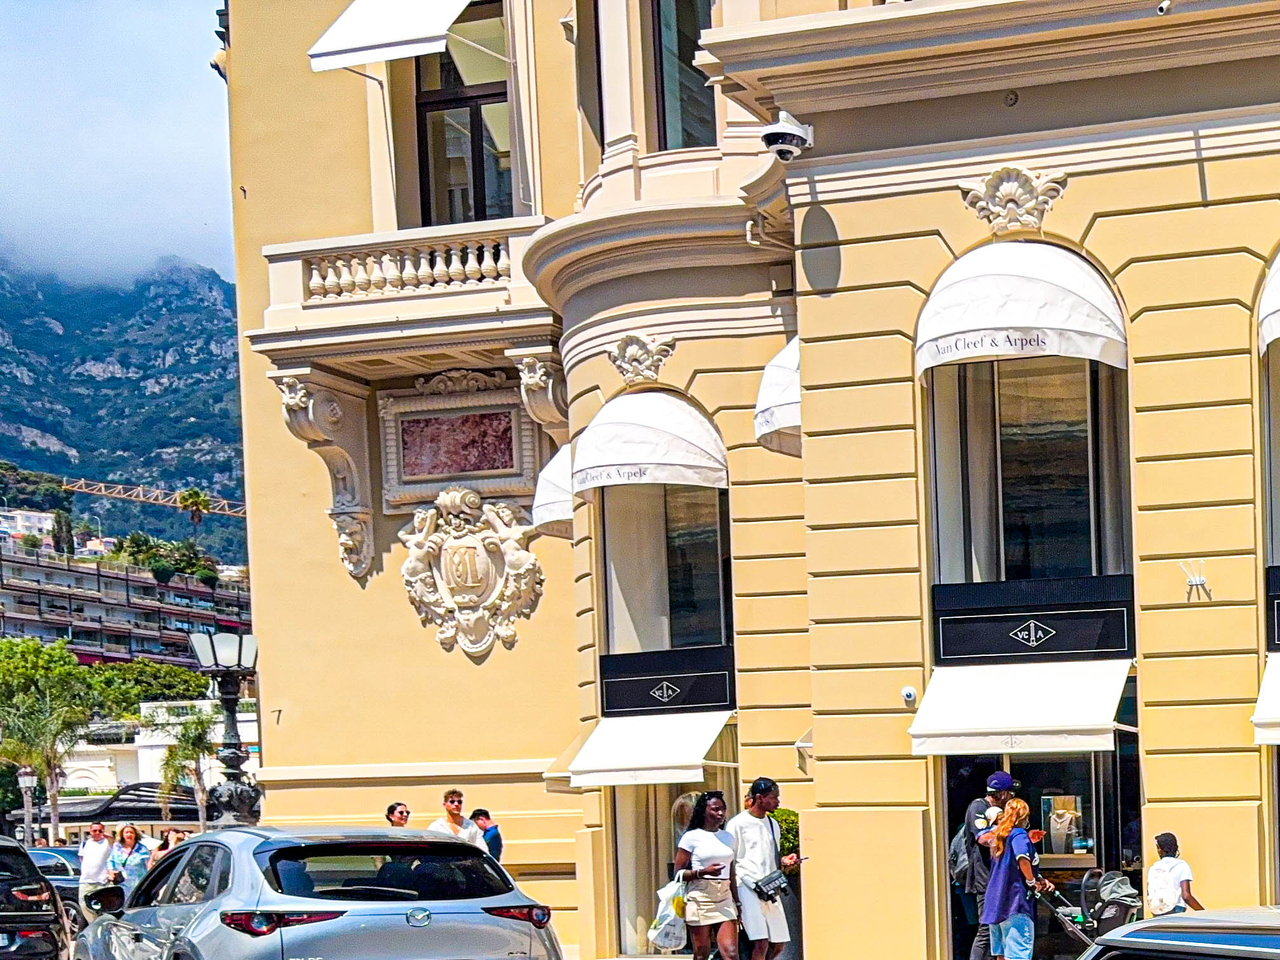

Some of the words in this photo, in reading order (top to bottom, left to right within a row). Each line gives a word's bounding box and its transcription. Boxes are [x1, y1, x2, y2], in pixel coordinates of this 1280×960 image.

[954, 335, 987, 351] Cleef
[990, 338, 999, 348] &
[1004, 334, 1047, 350] Arpels
